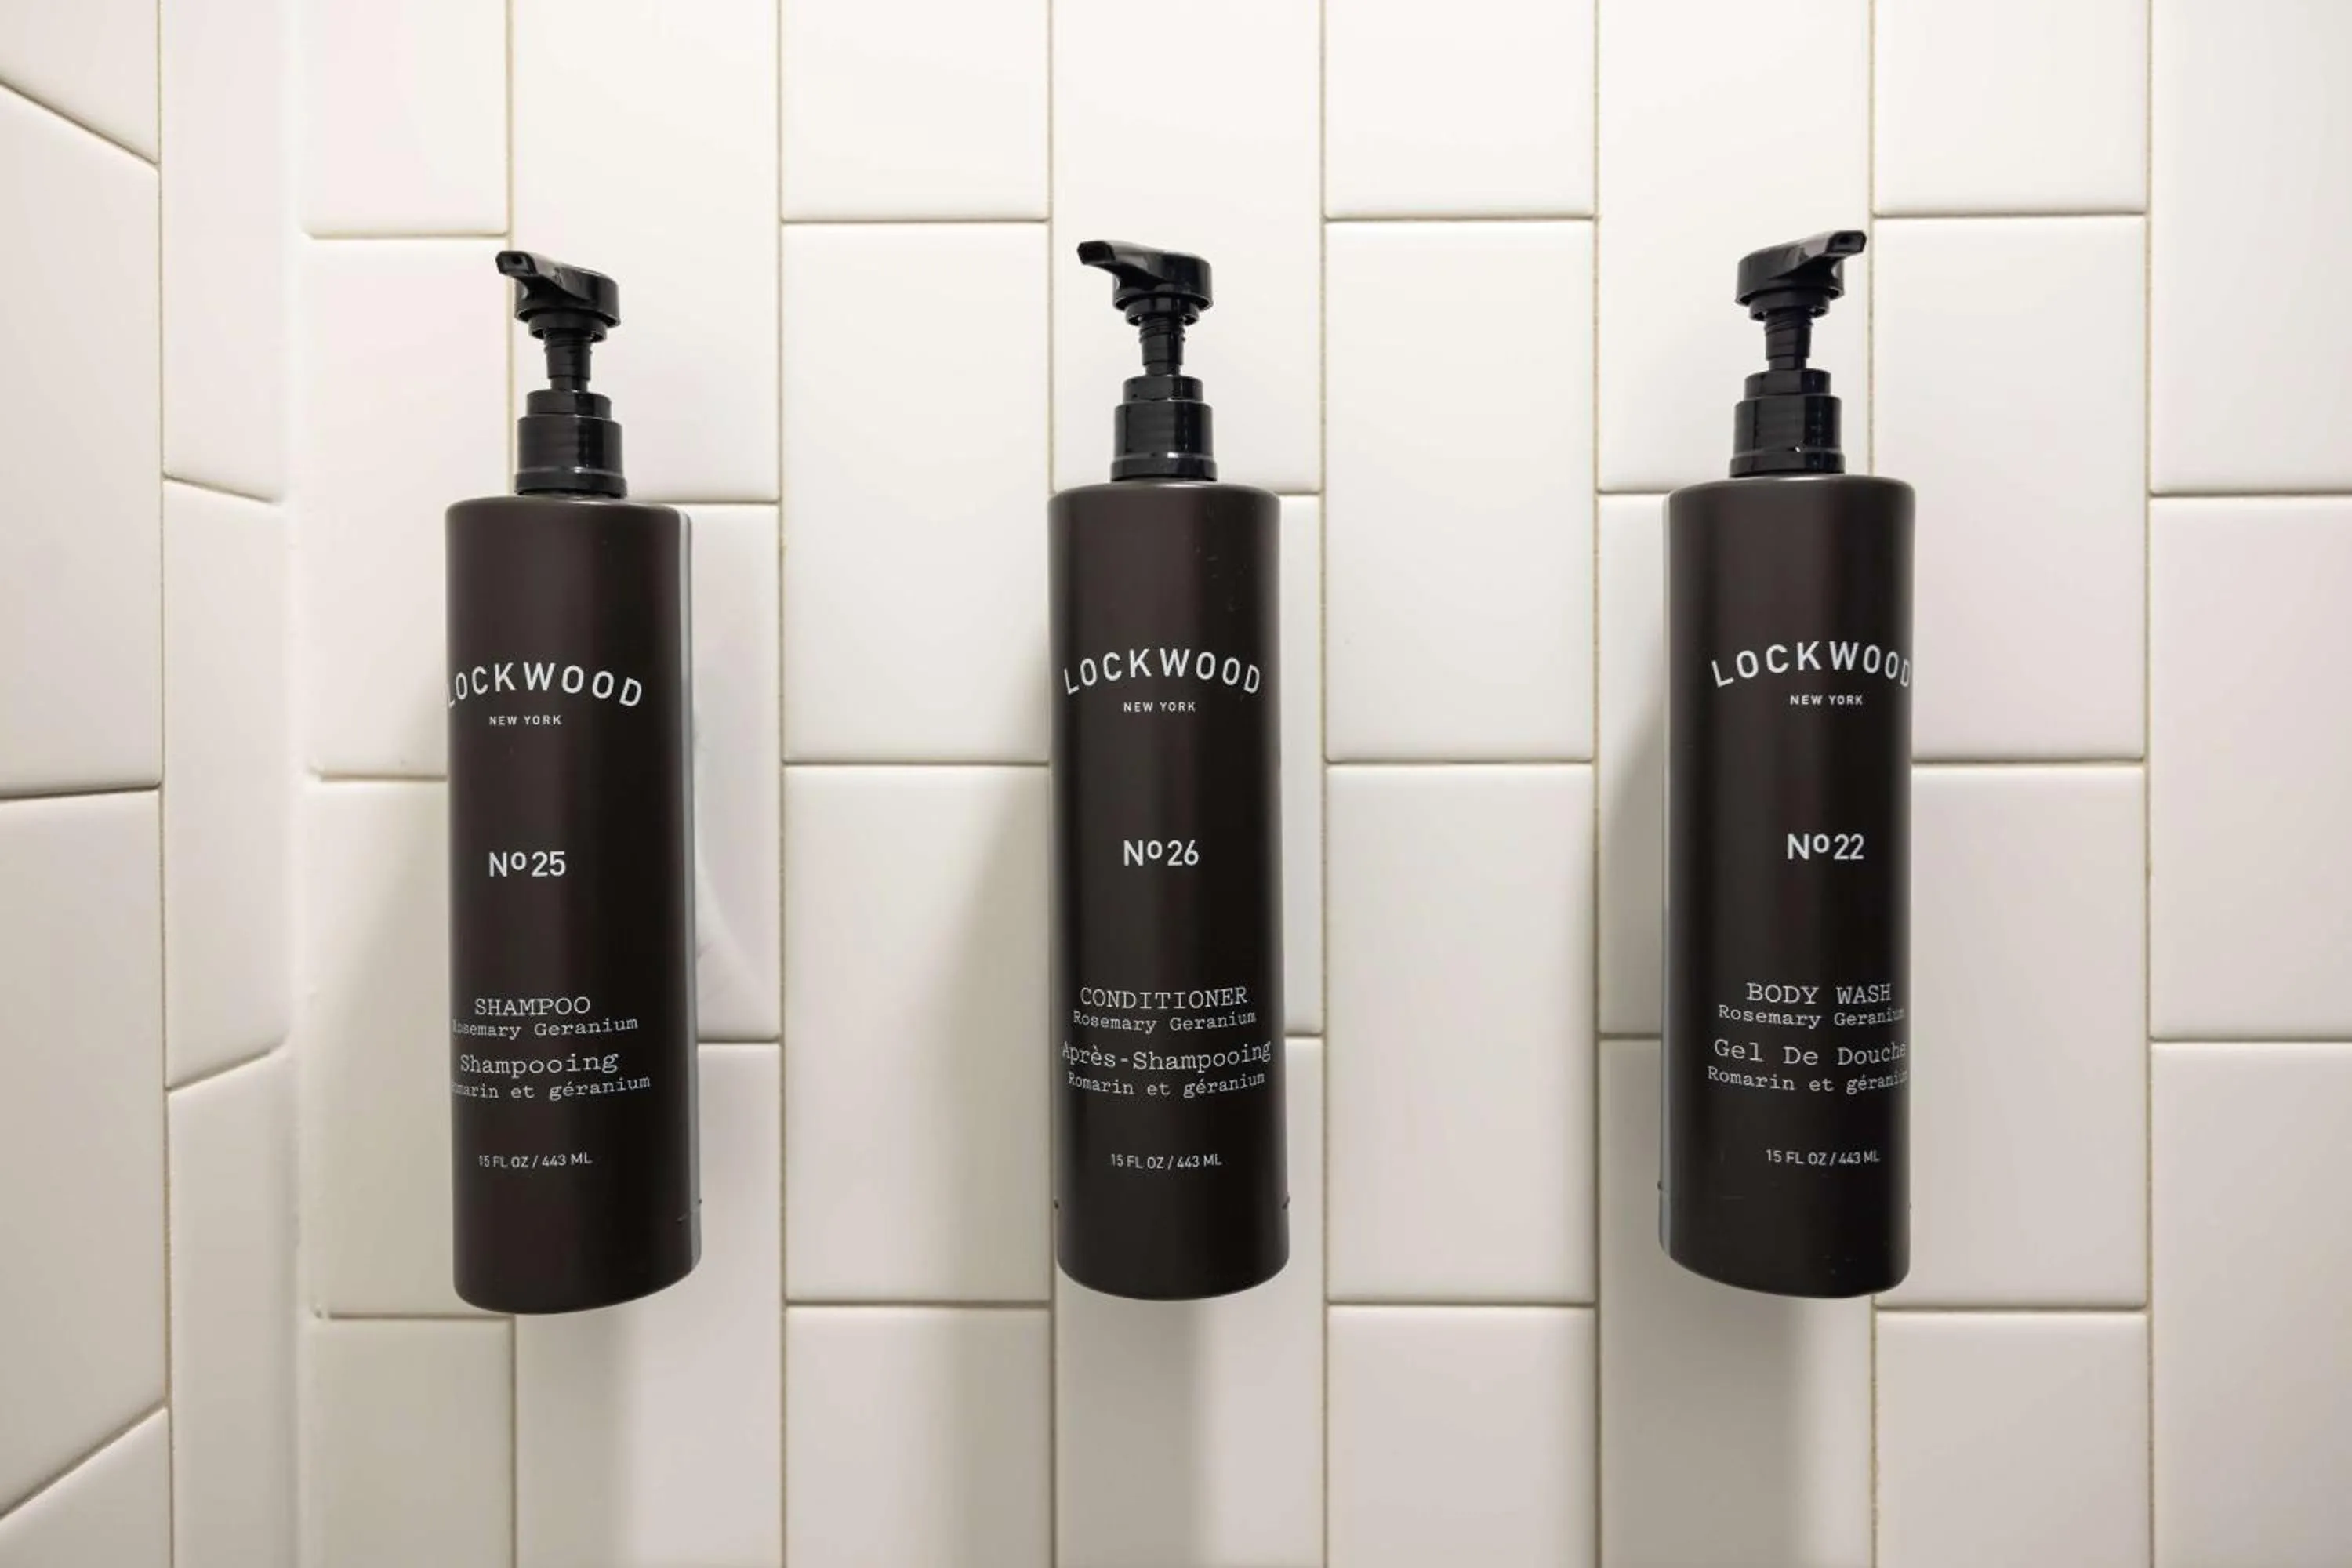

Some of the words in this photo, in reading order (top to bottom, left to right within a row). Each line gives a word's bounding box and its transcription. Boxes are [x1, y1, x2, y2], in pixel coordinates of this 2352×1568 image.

[1065, 648, 1259, 694] LOCKWOOD
[1712, 641, 1907, 687] LOCKWOOD
[1124, 702, 1152, 712] NEW
[1160, 702, 1195, 712] YORK
[1790, 695, 1822, 705] NEW
[1828, 695, 1862, 705] YORK
[489, 716, 517, 725] NEW
[524, 715, 561, 725] YORK
[1080, 986, 1247, 1009] CONDITIONER
[1747, 982, 1819, 1004] BODY
[1836, 983, 1891, 1004] WASH
[475, 996, 590, 1016] SHAMPOO
[1719, 1004, 1822, 1029] Rosemary
[534, 1018, 637, 1036] Geranium
[1073, 1010, 1157, 1035] Rosemary
[1170, 1011, 1256, 1031] Geranium
[1063, 1041, 1270, 1073] Après-Shampooing
[1715, 1039, 1763, 1062] Gel
[1784, 1046, 1818, 1065] De
[1838, 1042, 1907, 1065] Douche
[461, 1054, 621, 1079] Shampooing
[1708, 1066, 1795, 1090] Romarin
[1809, 1079, 1834, 1091] et
[511, 1086, 535, 1098] et
[550, 1076, 650, 1101] géranium
[1069, 1071, 1134, 1094] Romarin
[1147, 1083, 1170, 1097] et
[1183, 1071, 1265, 1098] géranium
[479, 1155, 489, 1167] 15
[493, 1156, 508, 1168] FL
[511, 1156, 528, 1167] OZ
[542, 1154, 566, 1167] 443
[571, 1152, 592, 1164] ML
[1112, 1154, 1123, 1167] 15
[1127, 1155, 1144, 1169] FL
[1147, 1156, 1163, 1169] OZ
[1177, 1155, 1200, 1167] 443
[1203, 1154, 1221, 1167] ML
[1766, 1149, 1782, 1162] 15
[1786, 1152, 1804, 1164] FL
[1808, 1152, 1827, 1165] OZ
[1838, 1152, 1860, 1164] 443
[1864, 1150, 1880, 1163] ML
